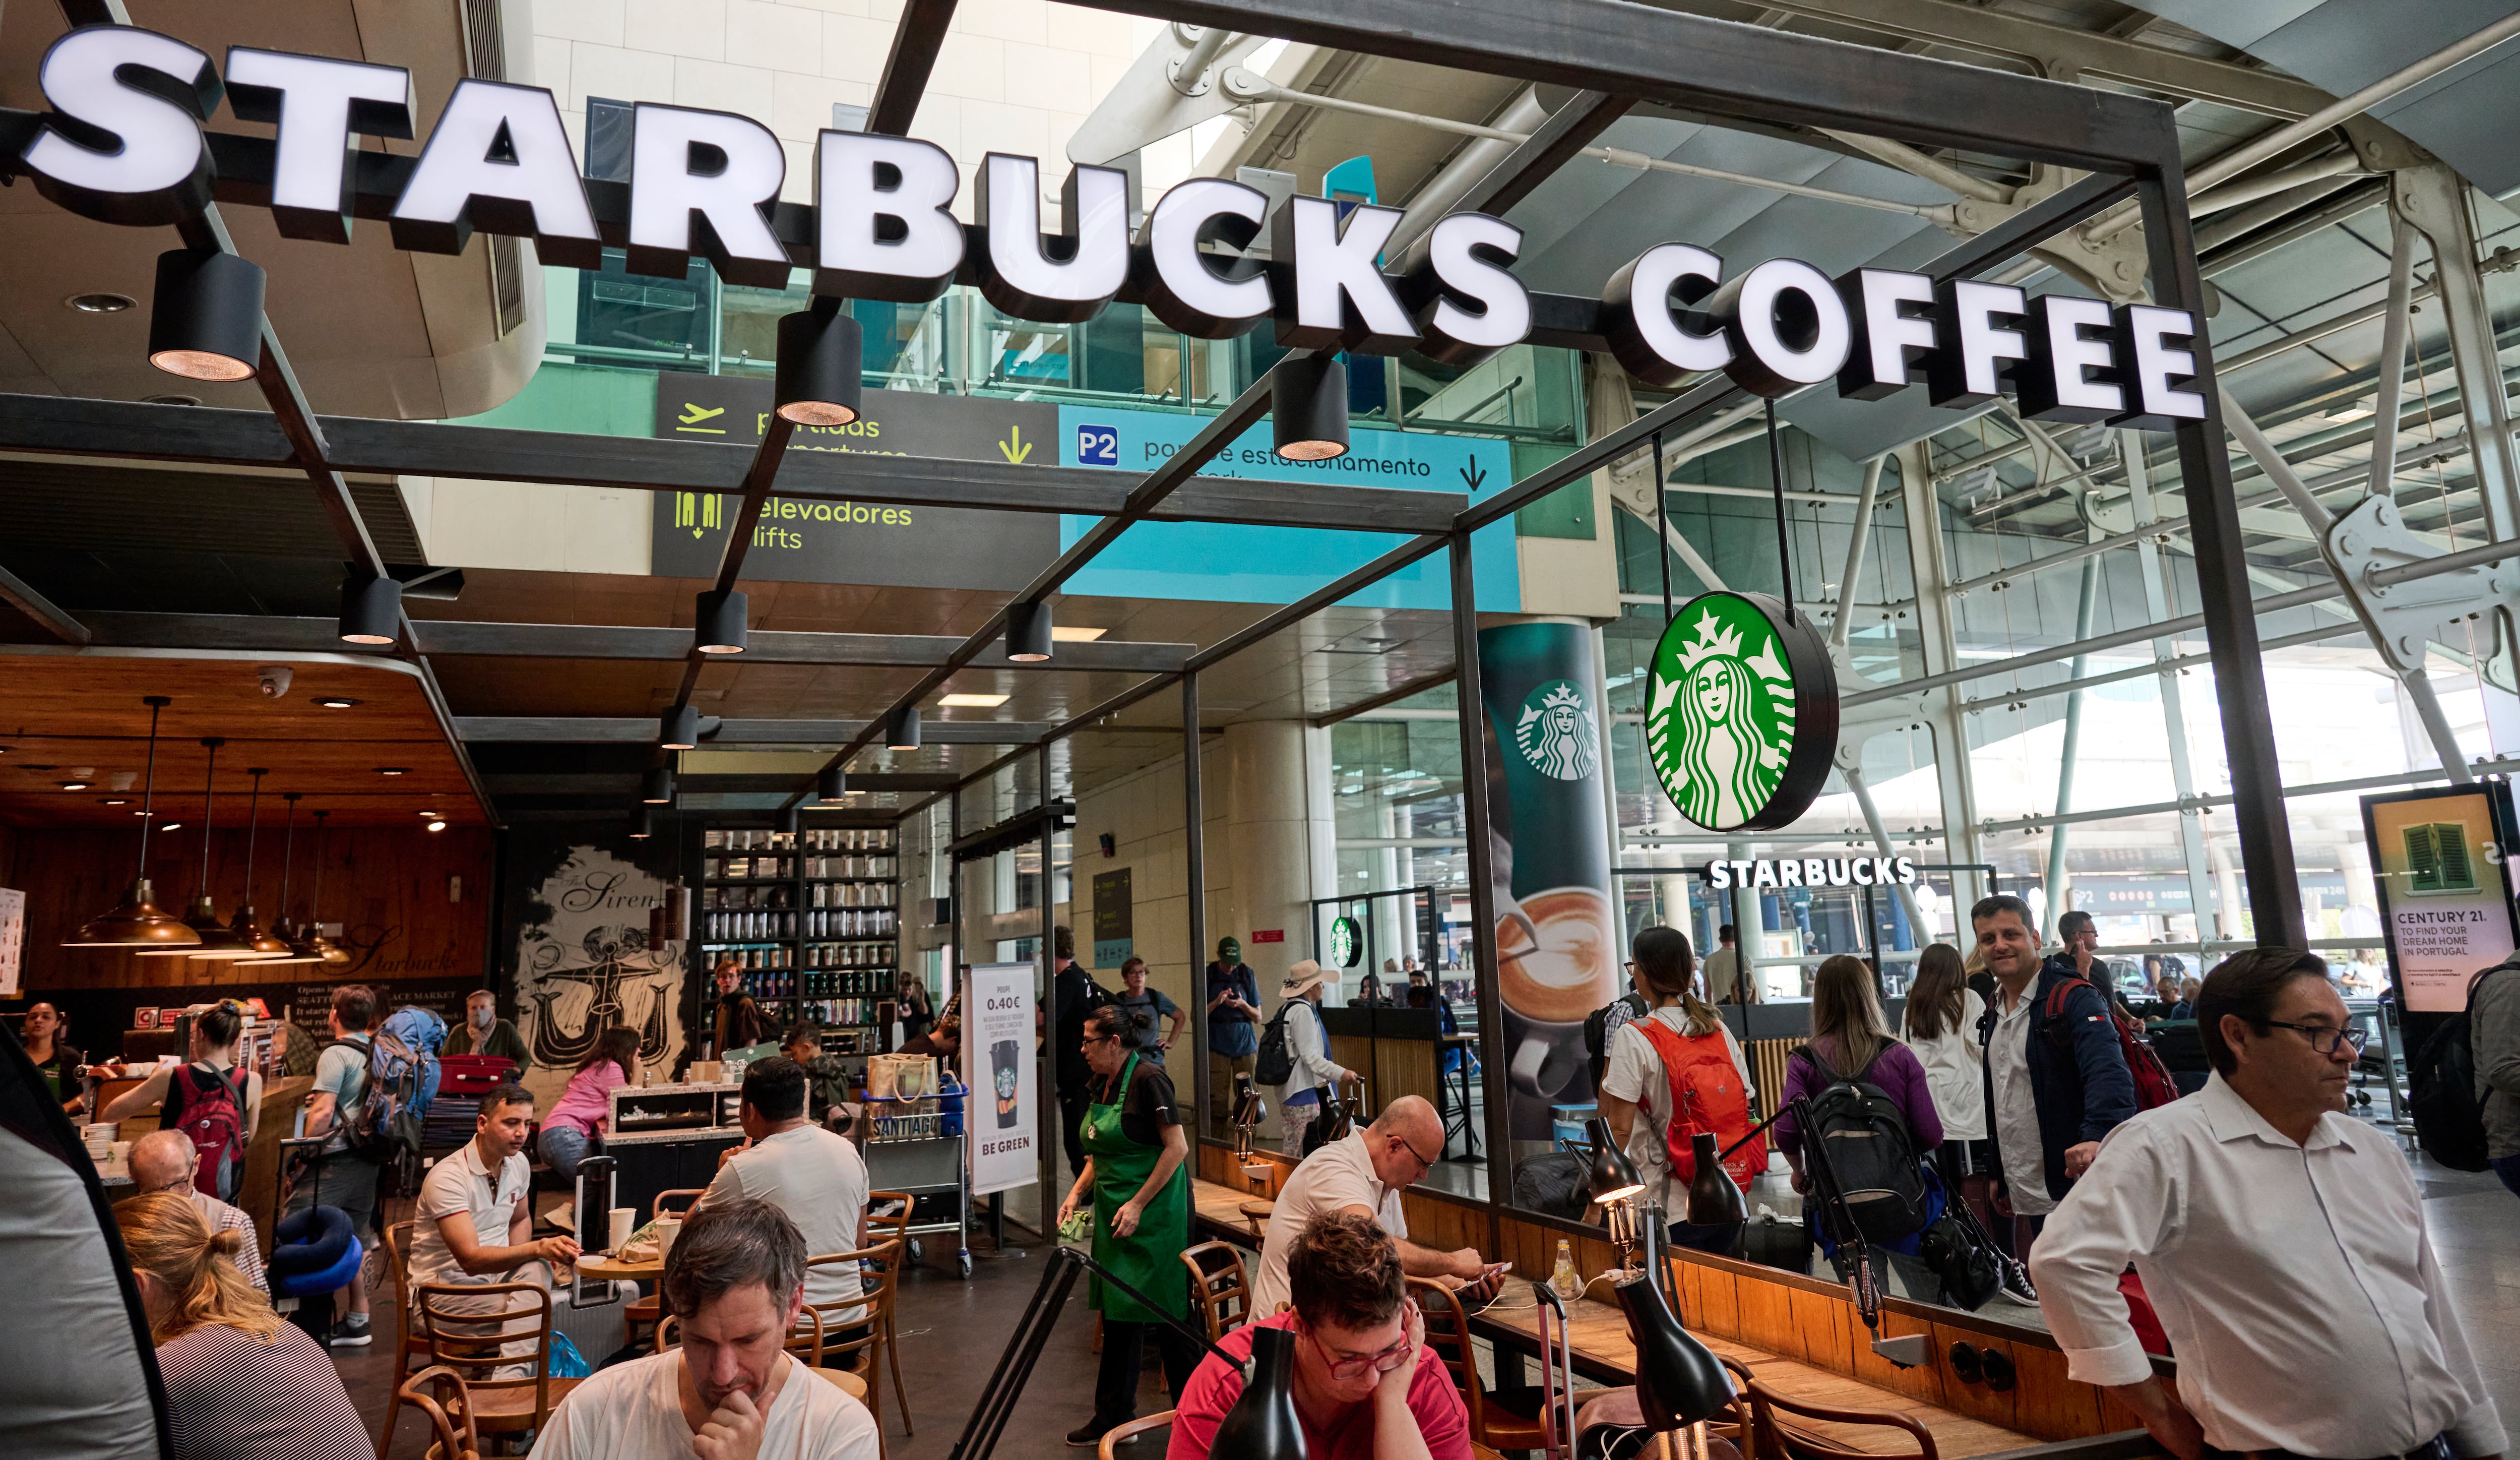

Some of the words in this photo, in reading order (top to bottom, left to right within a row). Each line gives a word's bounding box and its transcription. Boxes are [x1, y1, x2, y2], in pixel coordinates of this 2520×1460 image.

[20, 24, 1535, 348] STARBUCKS
[1629, 242, 2209, 421] COFFEE
[1079, 432, 1118, 459] P2
[759, 497, 912, 526] elevadores
[753, 526, 802, 549] lifts
[1708, 856, 1917, 889] STARBUCKS
[560, 871, 654, 913] Siren
[2398, 910, 2466, 924] CENTURY
[2401, 928, 2414, 936] TO
[2416, 927, 2438, 935] FIND
[2440, 926, 2467, 935] YOUR
[2403, 937, 2436, 946] DREAM
[2439, 936, 2468, 945] HOME
[2405, 948, 2414, 956] IN
[2416, 947, 2469, 956] PORTUGAL
[296, 995, 333, 1005] SEATT
[987, 996, 1020, 1010] 0.40€
[982, 1142, 995, 1156] BE
[998, 1136, 1030, 1153] GREEN
